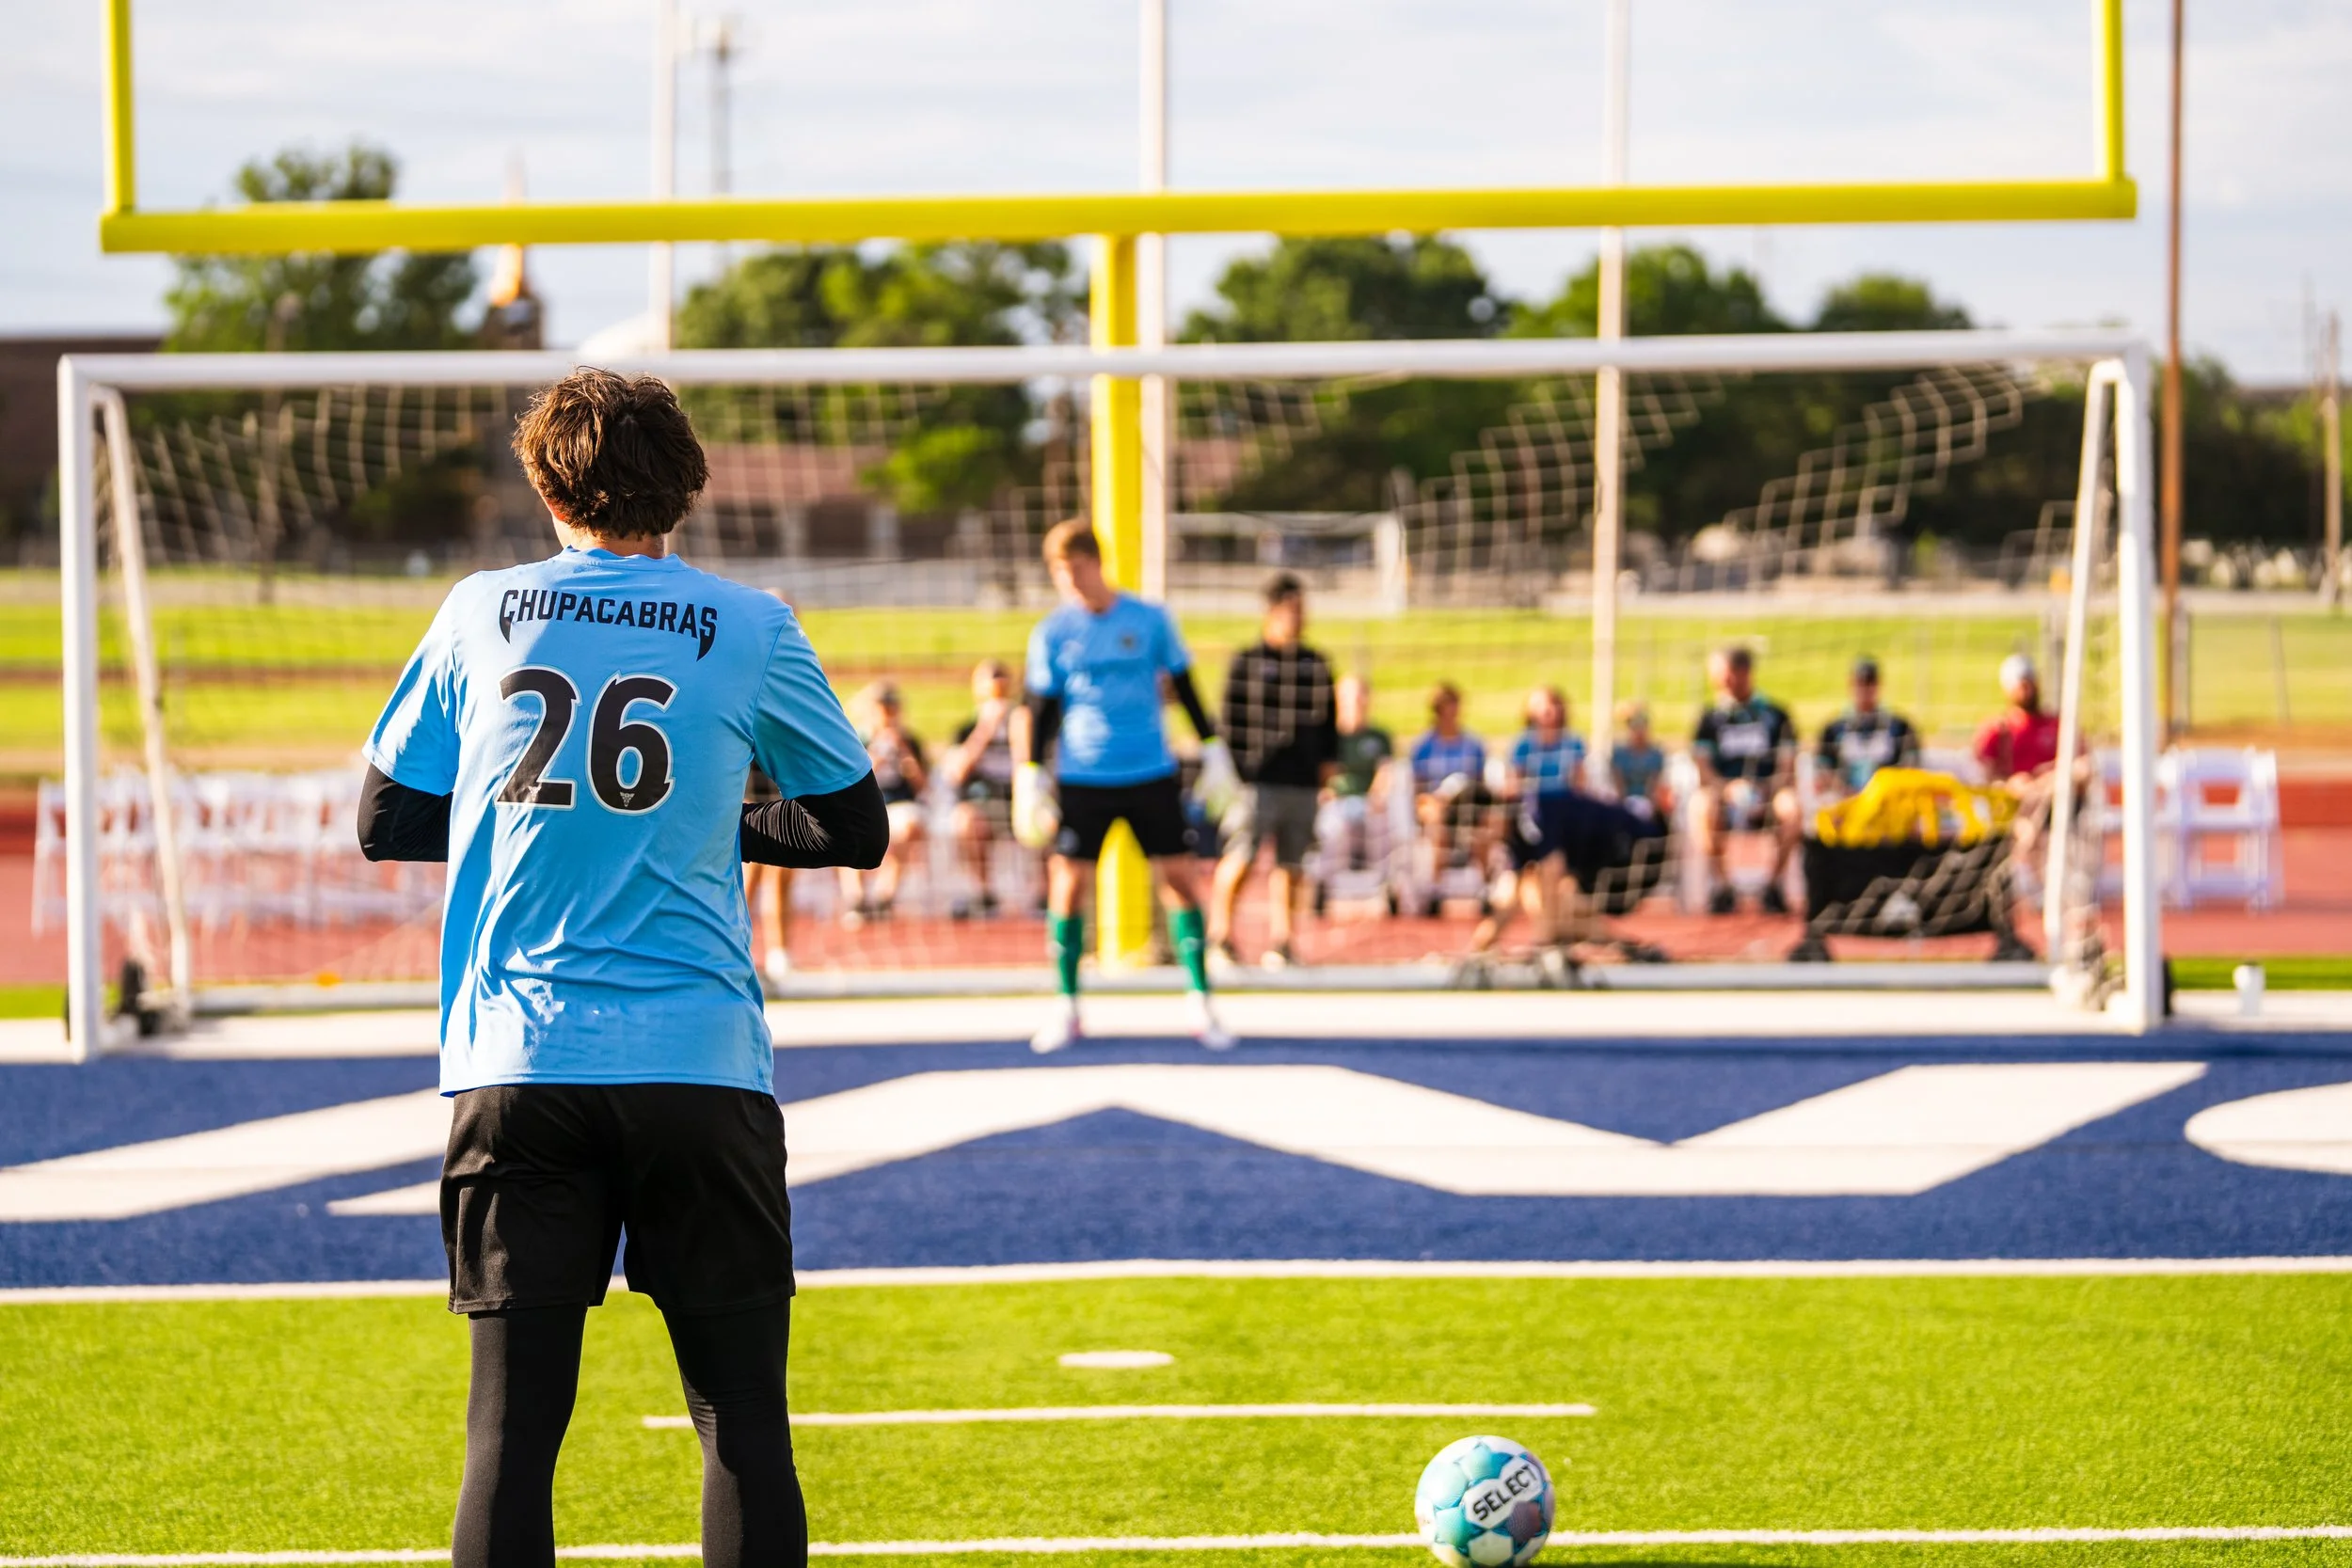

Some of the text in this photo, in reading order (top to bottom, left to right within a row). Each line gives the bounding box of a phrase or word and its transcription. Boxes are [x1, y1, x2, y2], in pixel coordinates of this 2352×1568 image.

[499, 589, 718, 662] CHUPACABRAS
[495, 664, 678, 815] 26
[1472, 1464, 1537, 1521] SELECT
